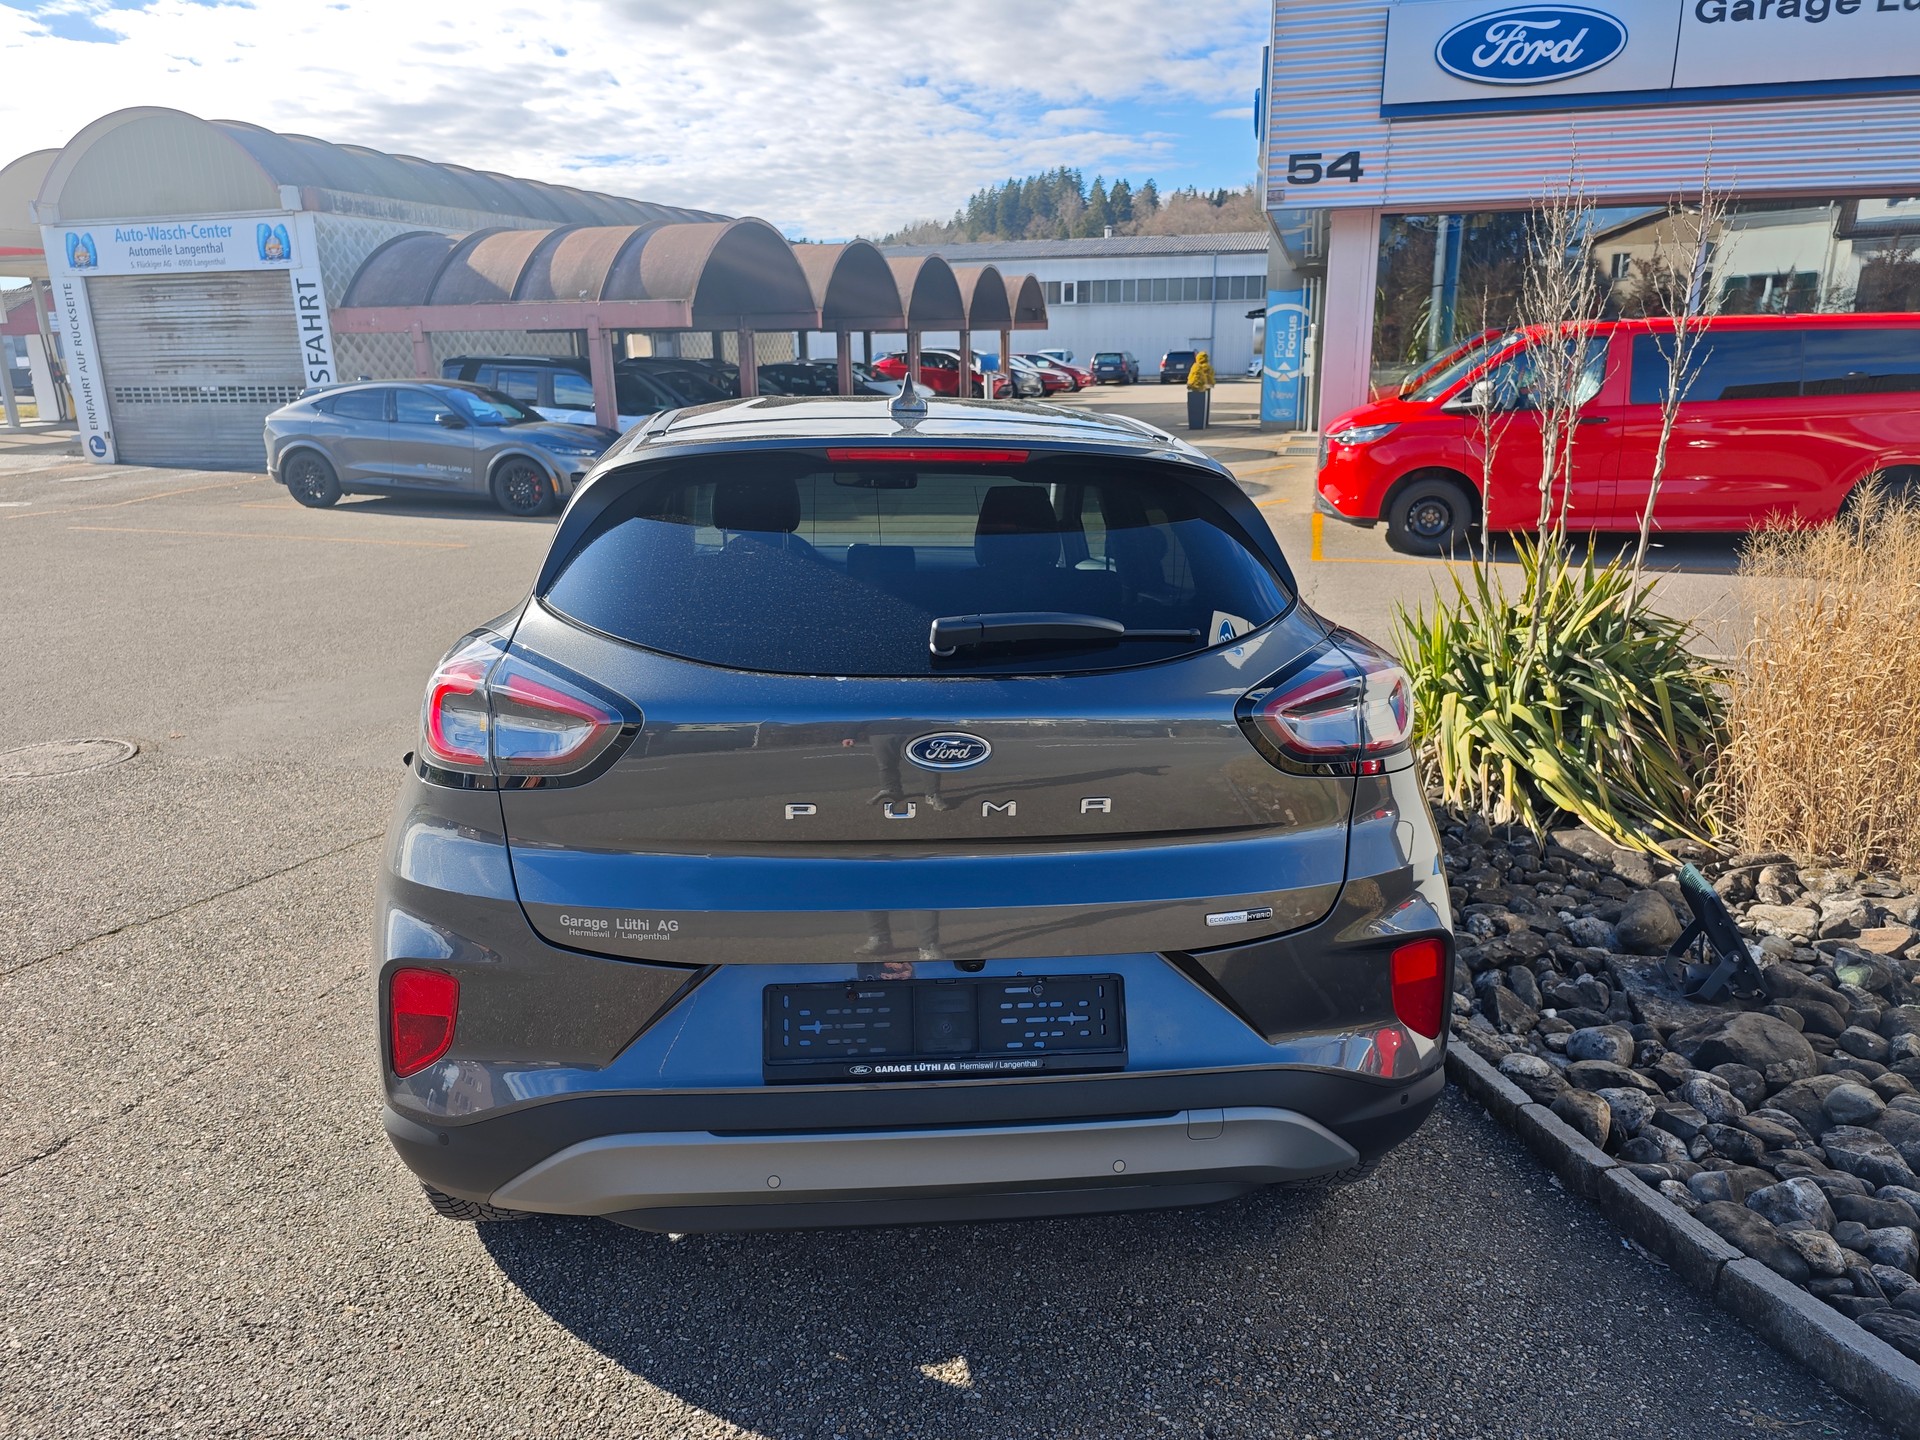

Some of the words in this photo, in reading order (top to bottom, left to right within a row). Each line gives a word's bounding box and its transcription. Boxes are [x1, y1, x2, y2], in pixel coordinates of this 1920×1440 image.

[1695, 0, 1861, 24] Garage
[1472, 19, 1589, 67] Ford
[1287, 151, 1364, 185] 54
[115, 224, 232, 243] Auto-Wasch-Center
[129, 245, 173, 257] Automeile
[174, 242, 224, 258] Langenthal
[163, 260, 172, 268] AG
[193, 258, 226, 268] Langenthal
[63, 283, 83, 347] RÜCKSEITE
[1274, 331, 1285, 358] Ford
[1285, 315, 1297, 358] Focus
[76, 350, 88, 373] AUF
[81, 376, 99, 431] EINFAHRT
[925, 740, 972, 759] Ford
[785, 797, 1112, 820] PUMA
[559, 914, 609, 931] Garage
[616, 918, 650, 931] Lüthi
[657, 919, 679, 932] AG
[1247, 911, 1271, 920] HYBRID
[568, 928, 610, 938] Hermiswil
[622, 931, 670, 941] Langenthal
[875, 1064, 912, 1073] GARAGE
[914, 1062, 941, 1072] LÜTHI
[943, 1063, 956, 1071] AG
[960, 1062, 993, 1070] Hermiswil
[999, 1060, 1038, 1069] Langenthal
